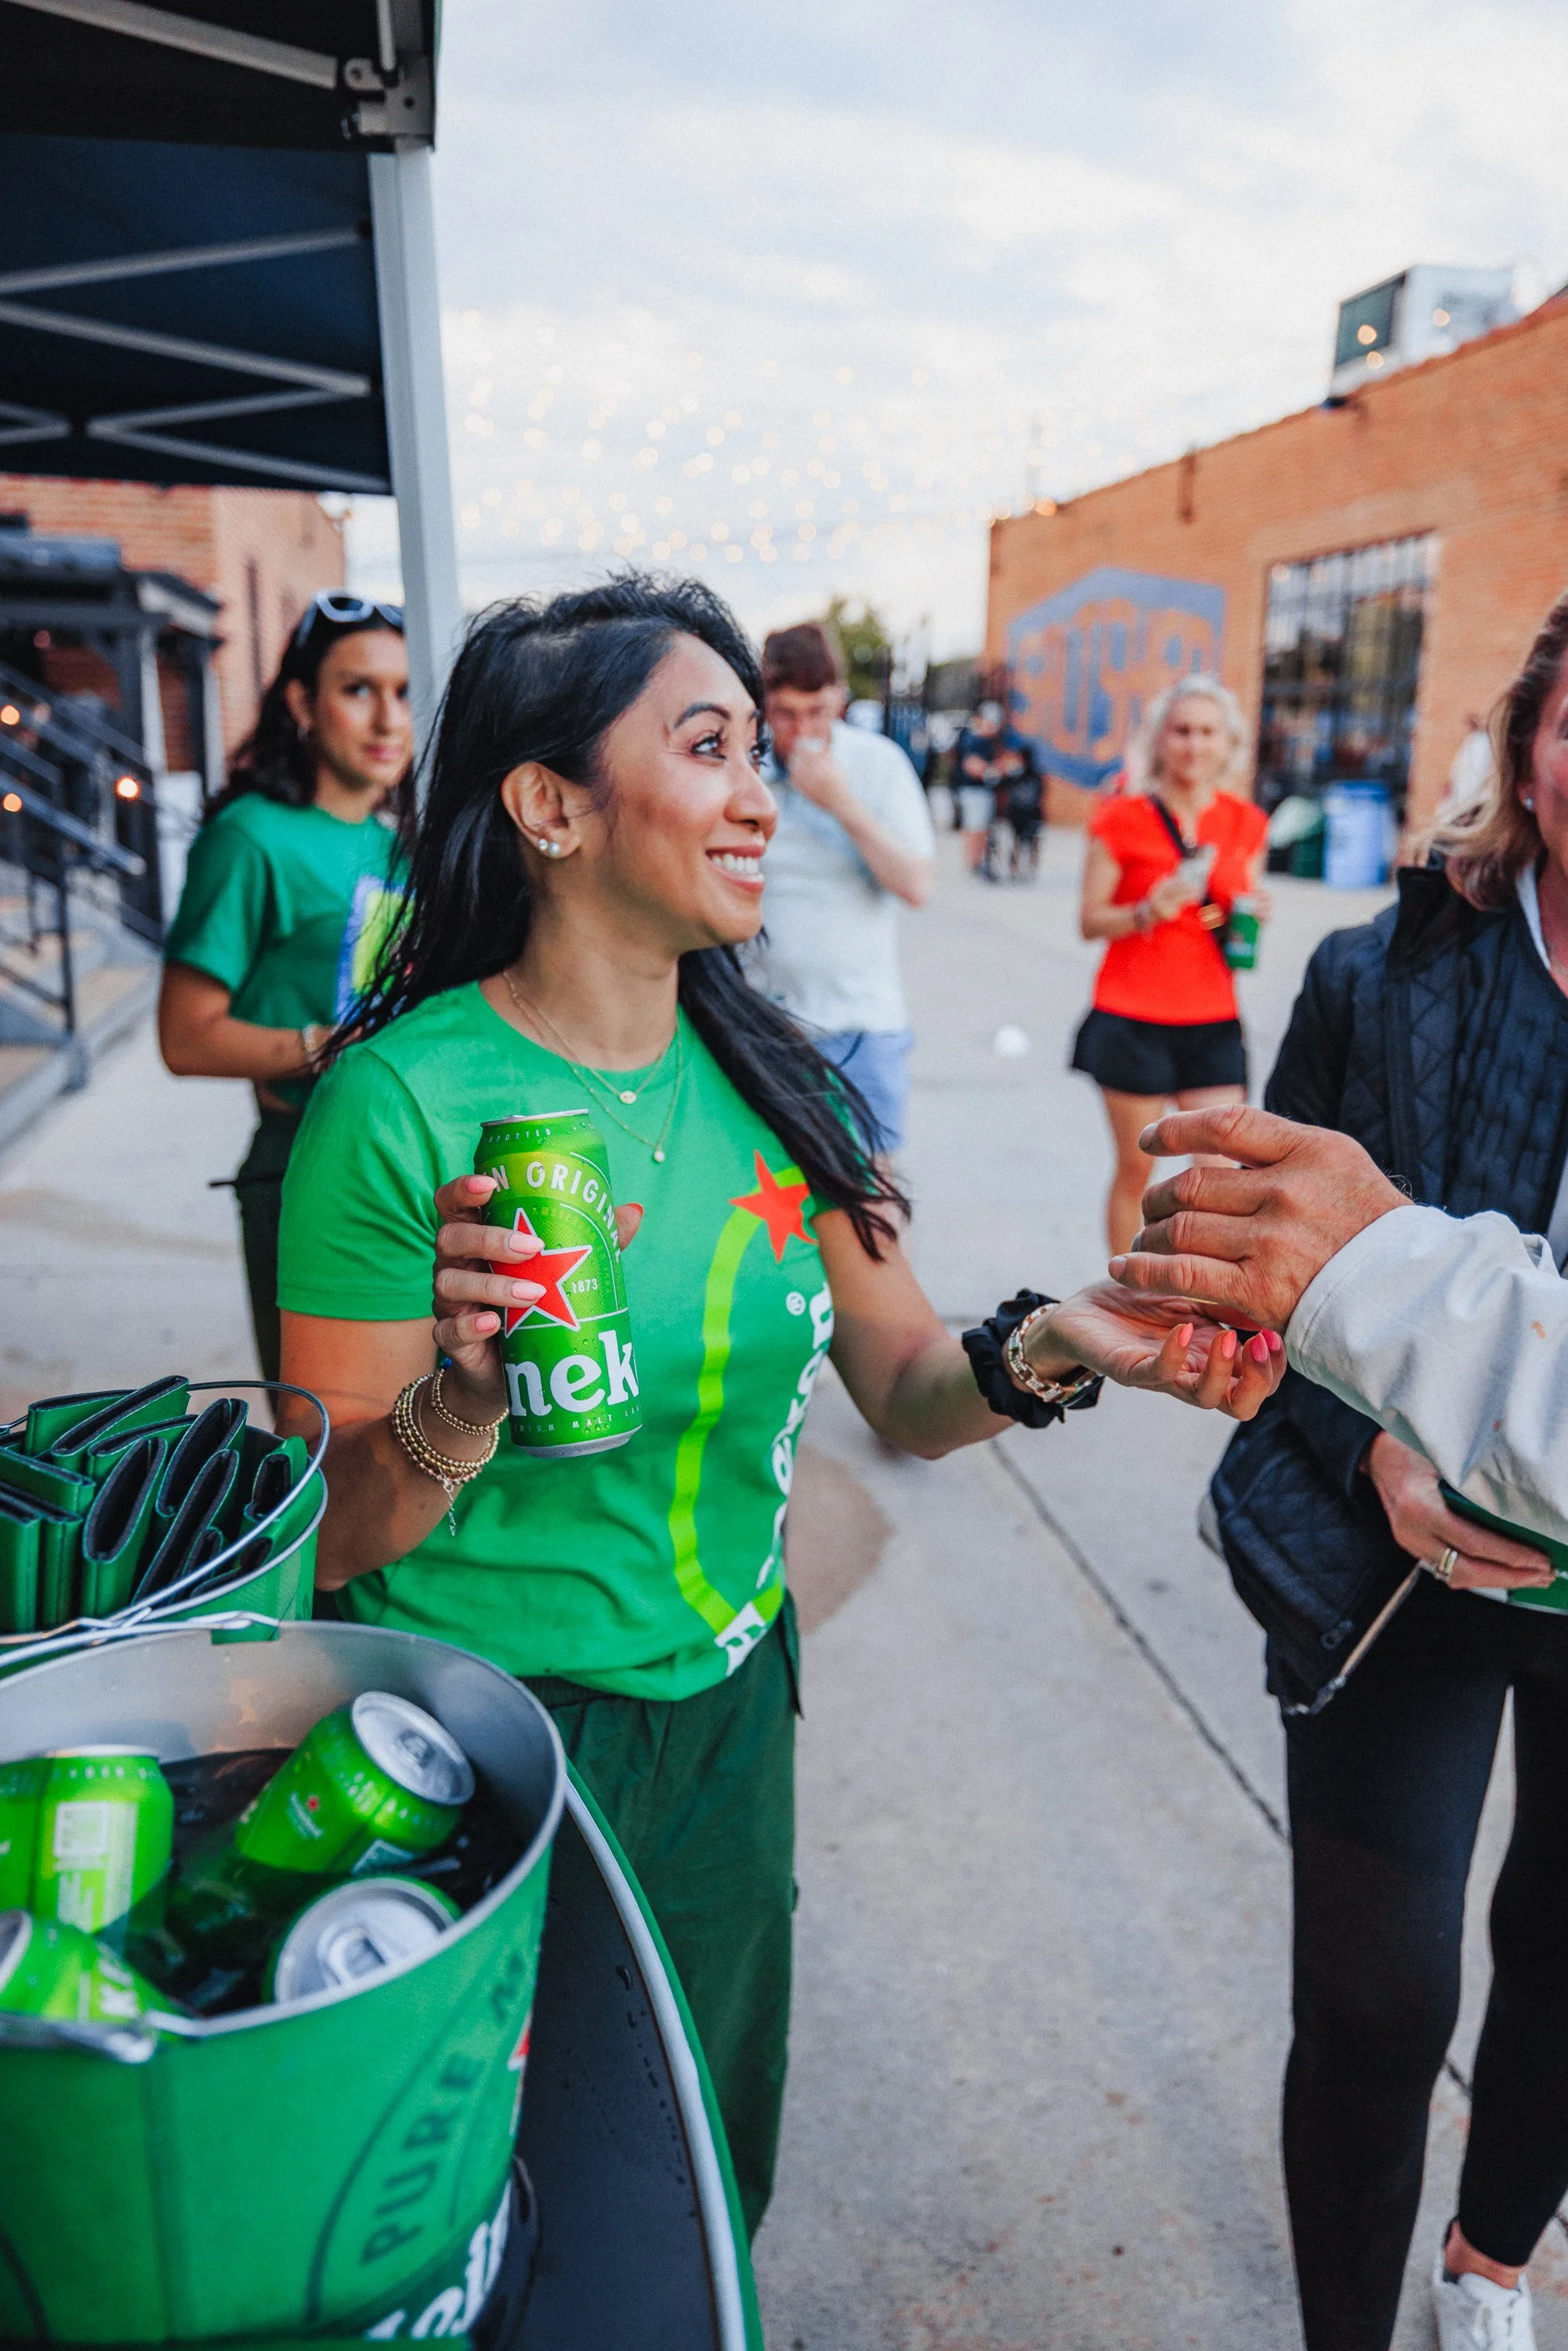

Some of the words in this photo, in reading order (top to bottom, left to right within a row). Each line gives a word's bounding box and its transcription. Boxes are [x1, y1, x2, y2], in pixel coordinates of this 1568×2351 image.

[570, 1278, 599, 1294] 1873
[572, 1414, 612, 1429] MALT
[358, 2052, 487, 2266] PURE
